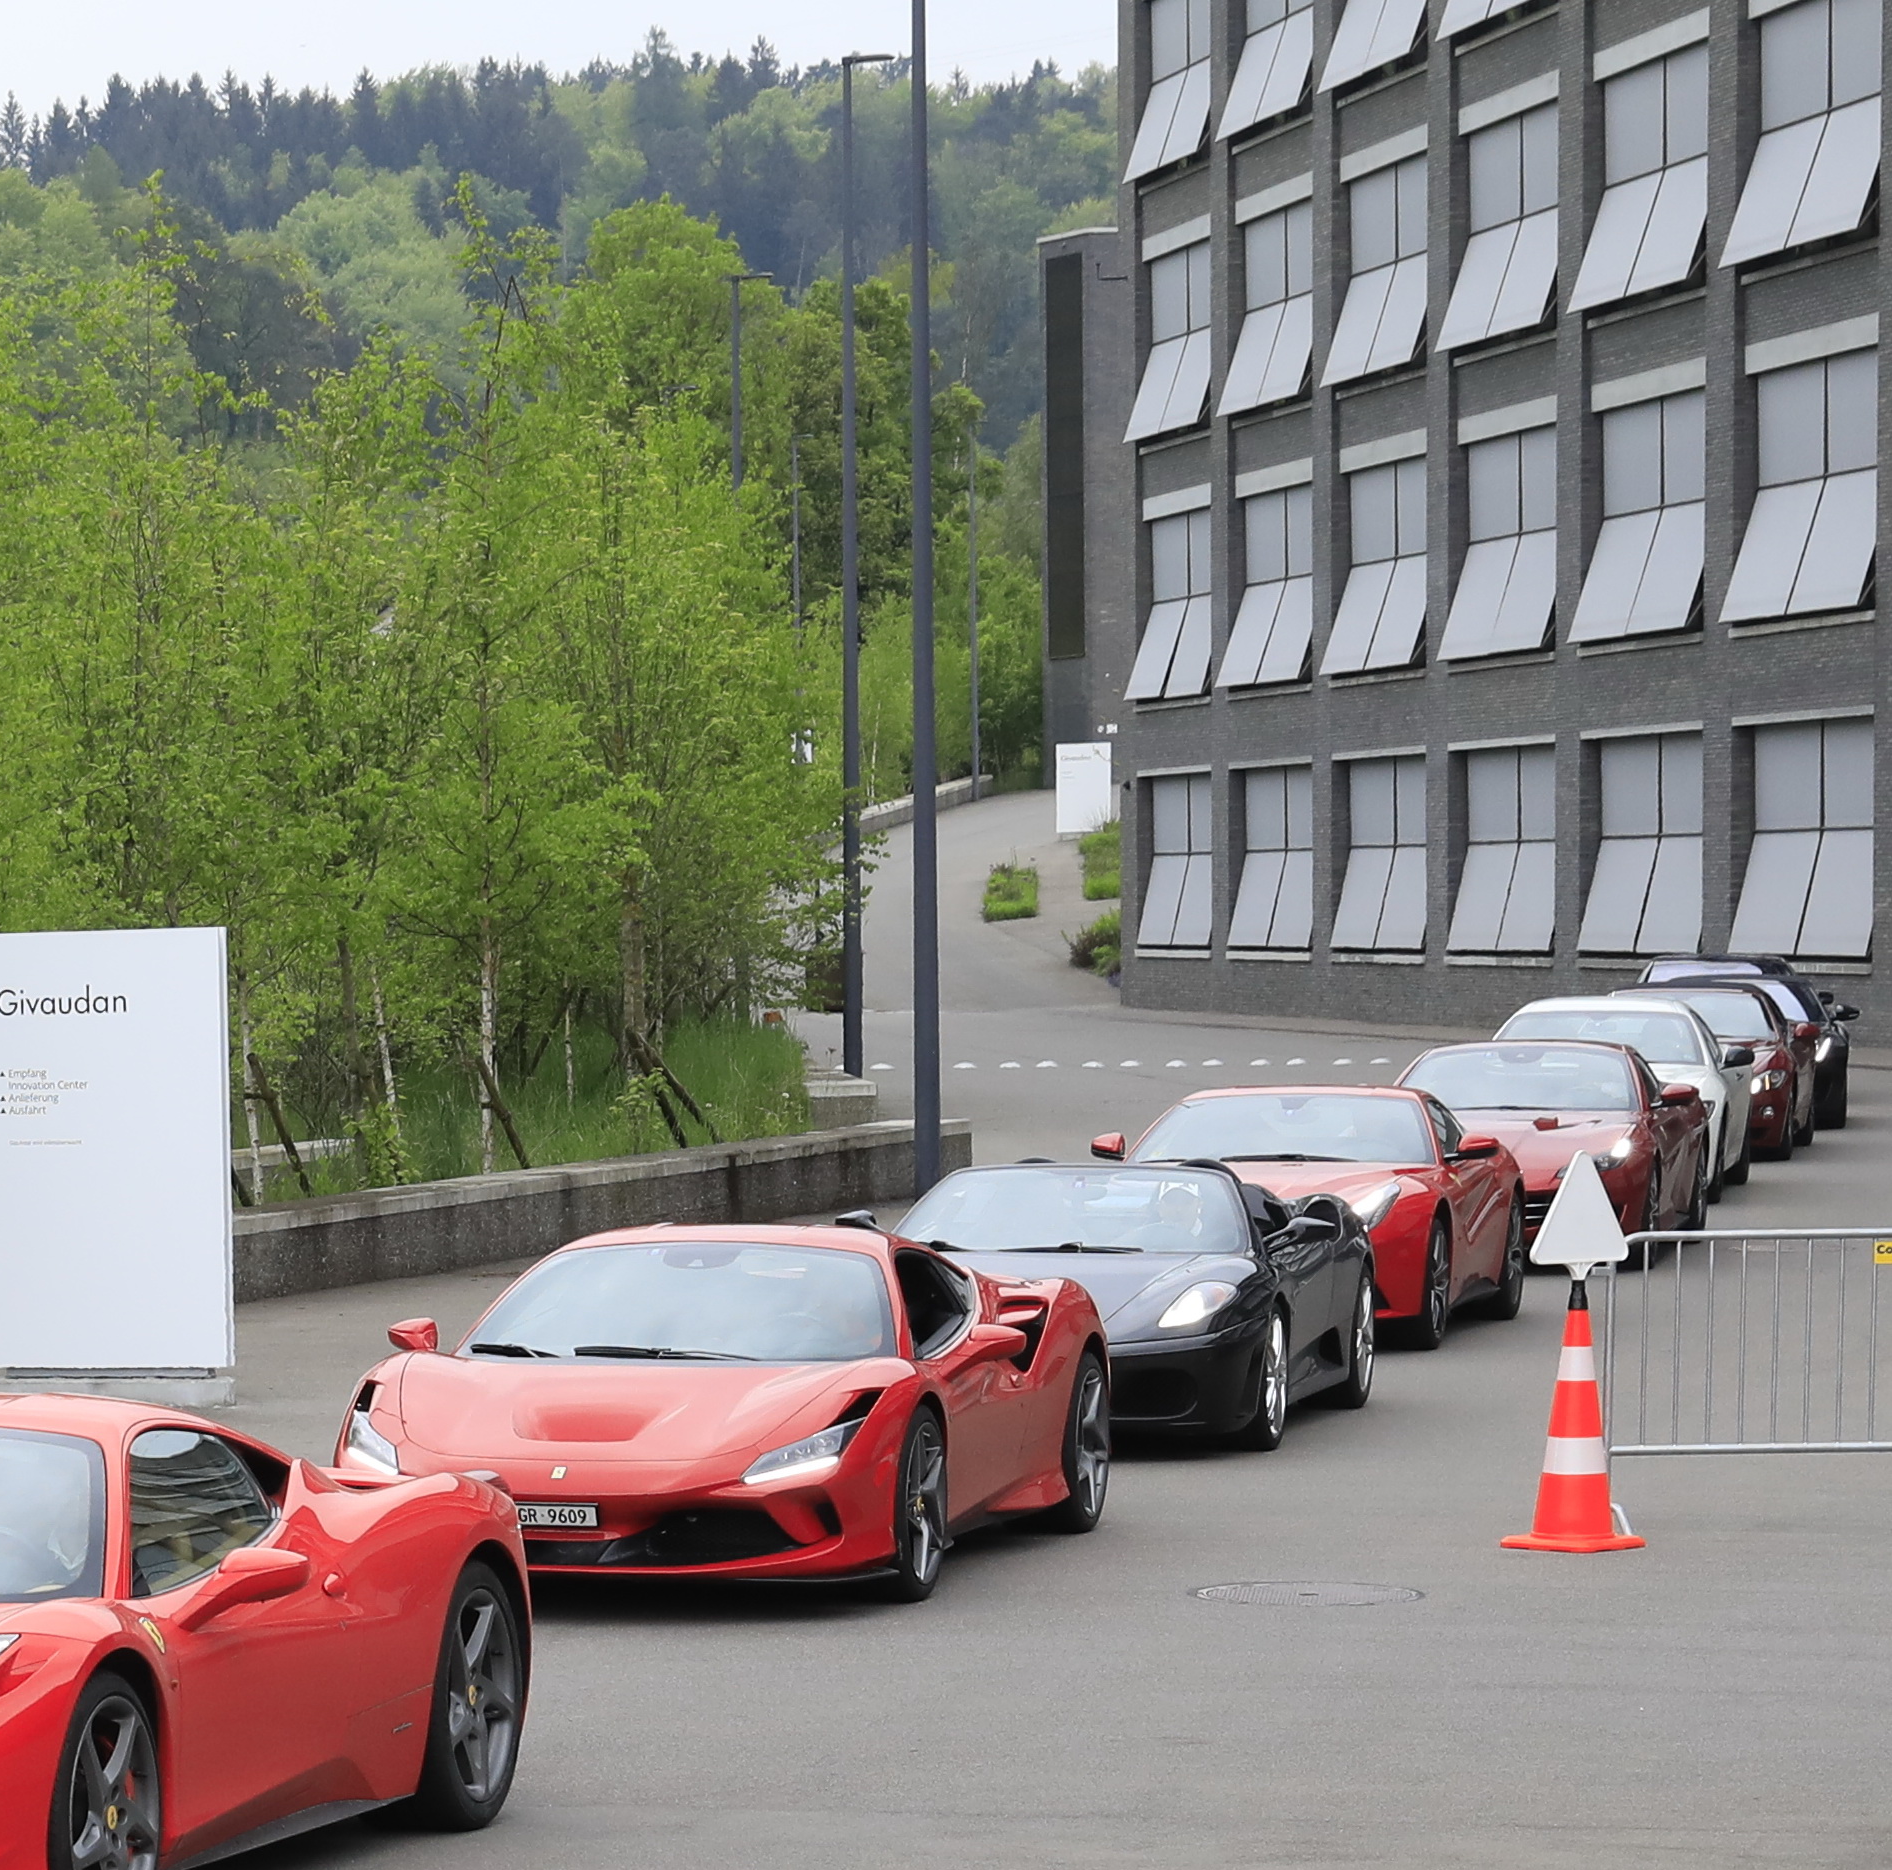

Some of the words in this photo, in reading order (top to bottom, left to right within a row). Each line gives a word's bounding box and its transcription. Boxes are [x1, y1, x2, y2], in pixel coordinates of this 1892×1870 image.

[8, 1068, 47, 1080] Empfang
[8, 1081, 55, 1090] Innovation
[57, 1080, 88, 1090] Center
[8, 1093, 59, 1104] Anlieferung
[8, 1105, 47, 1115] Ausfahrt
